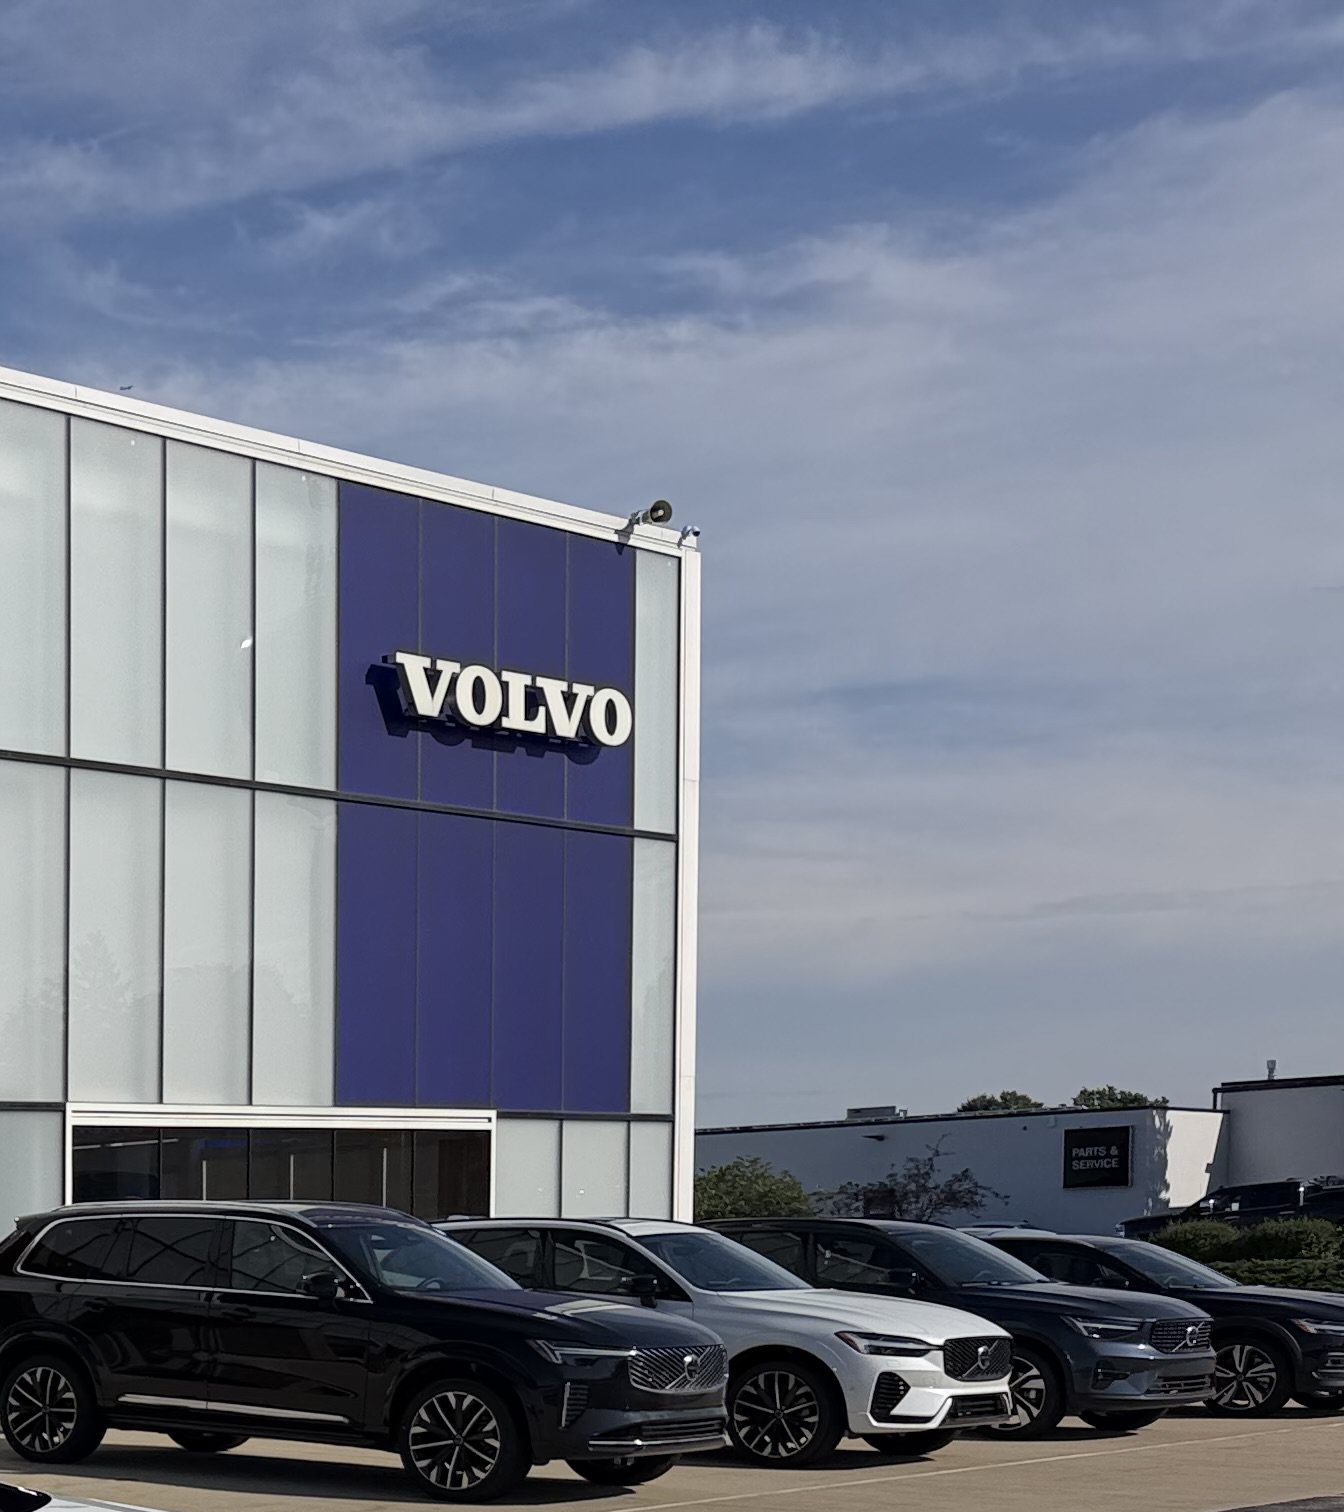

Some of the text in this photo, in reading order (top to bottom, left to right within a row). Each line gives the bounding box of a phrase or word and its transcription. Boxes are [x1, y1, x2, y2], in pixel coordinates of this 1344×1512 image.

[394, 651, 633, 747] VOLVO
[1072, 1145, 1119, 1157] PARTS &
[1072, 1158, 1119, 1170] SERVICE
